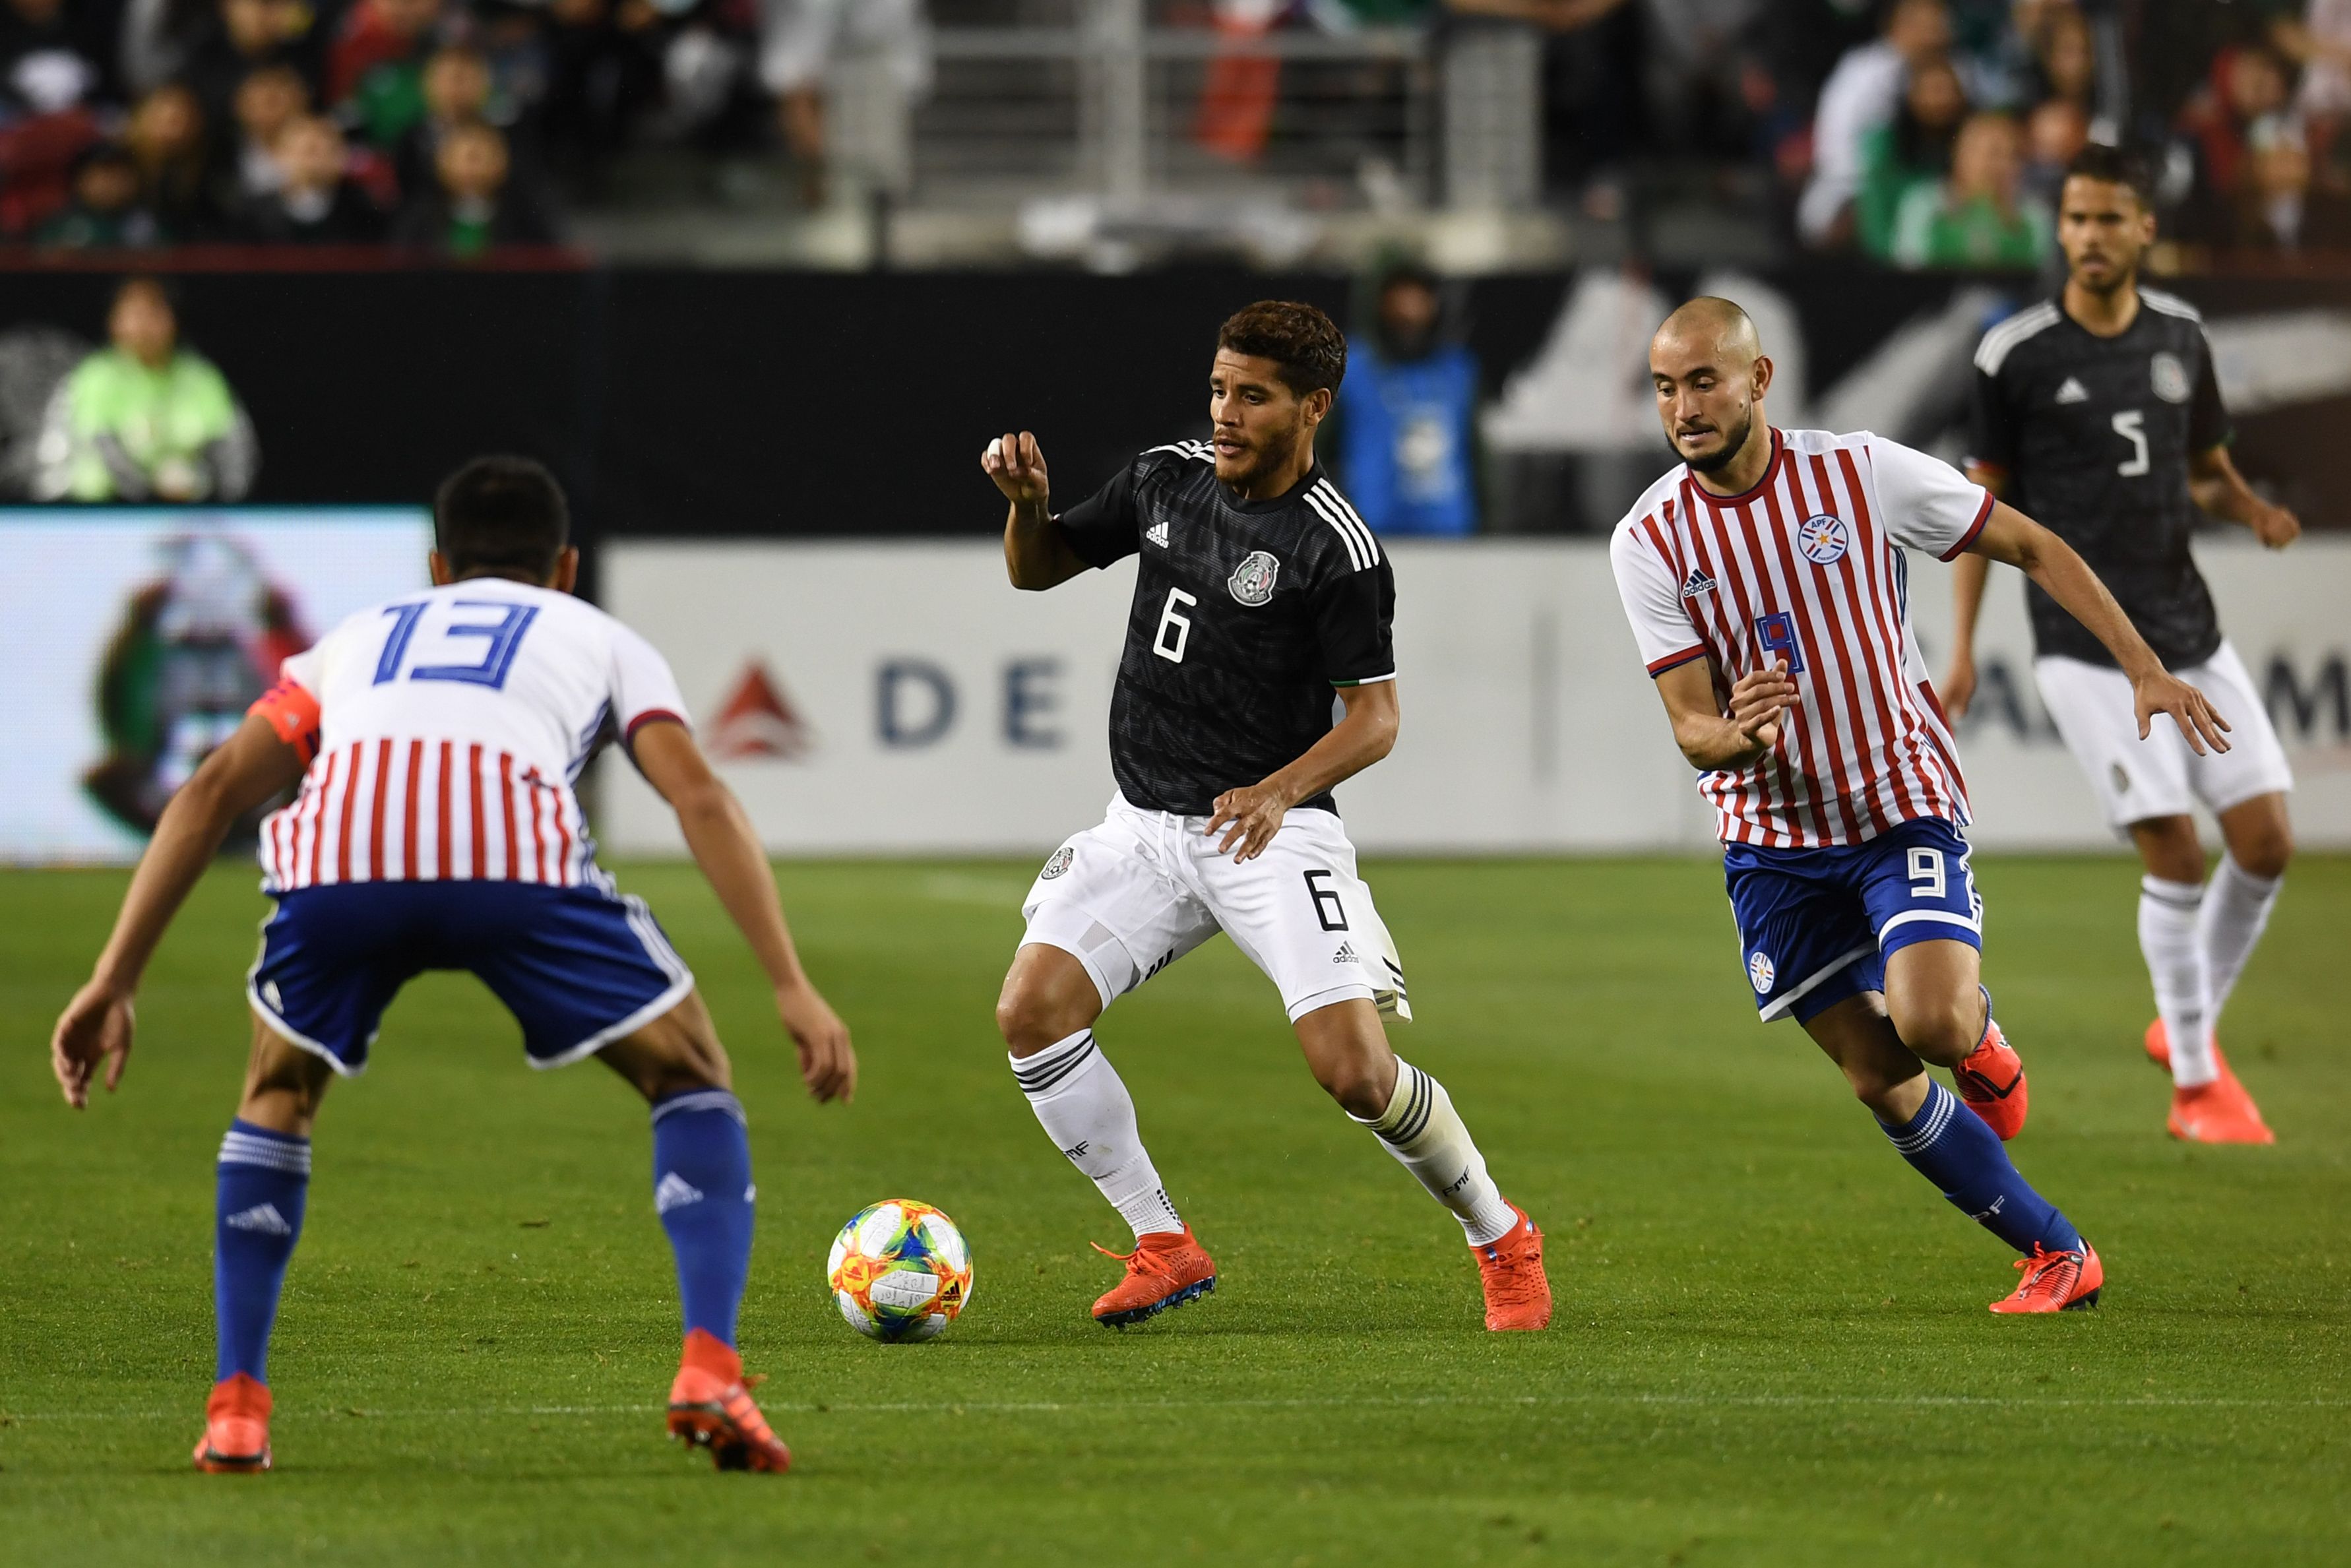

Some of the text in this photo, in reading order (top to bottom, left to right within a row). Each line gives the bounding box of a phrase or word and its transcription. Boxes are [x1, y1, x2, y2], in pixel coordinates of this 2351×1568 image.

[2112, 410, 2150, 478] 5
[1146, 530, 1170, 549] adidas
[1811, 518, 1827, 528] APF
[1683, 579, 1716, 596] adidas
[372, 600, 541, 690] 13
[1152, 586, 1197, 664] 6
[1755, 611, 1805, 675] 9
[875, 658, 1070, 749] DE
[1303, 869, 1349, 932] 6
[1906, 846, 1946, 898] 9
[1065, 1140, 1089, 1160] MF
[1443, 1164, 1470, 1197] FMF
